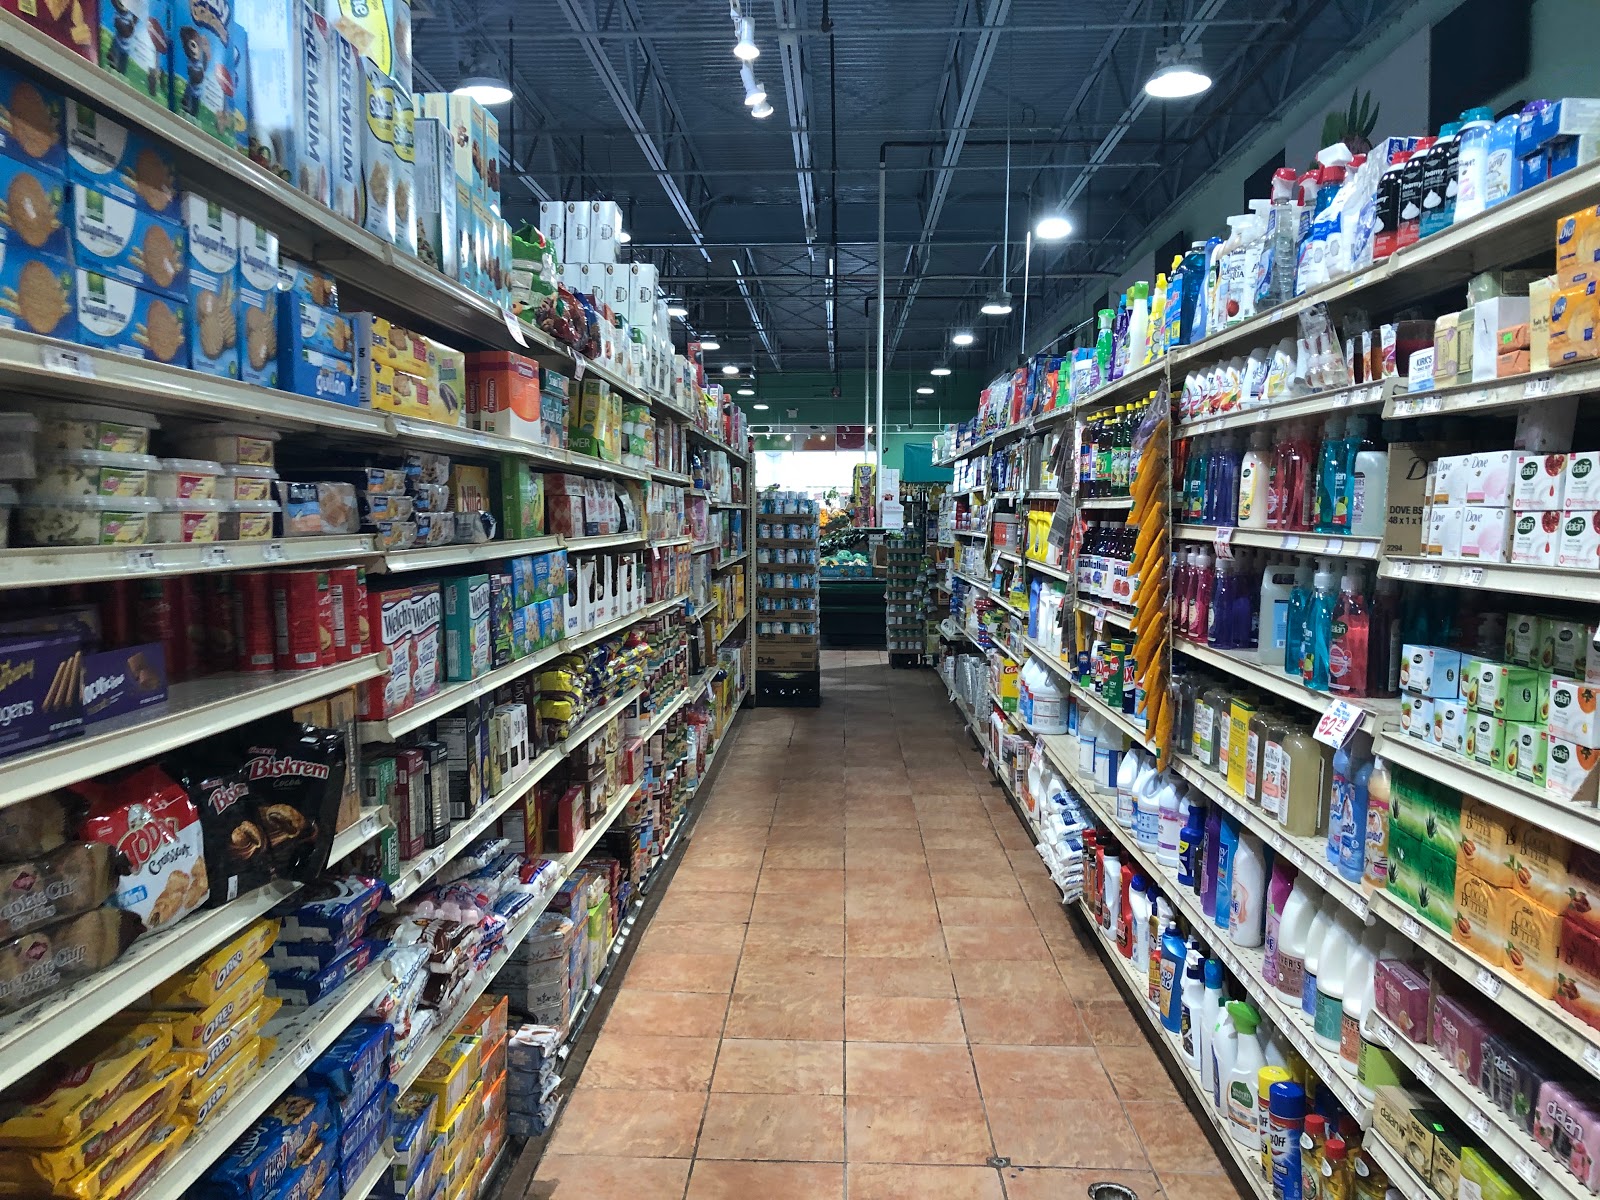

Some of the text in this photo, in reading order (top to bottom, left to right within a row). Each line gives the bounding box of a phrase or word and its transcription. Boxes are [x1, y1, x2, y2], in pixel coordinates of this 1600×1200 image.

[304, 5, 321, 163] PREMIUM
[340, 33, 354, 184] PREMIUM
[1424, 169, 1447, 178] foamy
[1402, 180, 1424, 190] foamy
[1559, 224, 1576, 240] Dial
[1417, 355, 1433, 367] KIRK'S
[1438, 459, 1453, 472] Dove
[1472, 456, 1489, 469] Dove
[1572, 462, 1591, 475] dalan
[1521, 465, 1538, 477] dalan
[1390, 505, 1412, 515] DOVE
[1432, 509, 1446, 522] Dove
[1465, 509, 1483, 523] Dove
[1388, 516, 1398, 525] 48
[1399, 517, 1405, 525] x
[1406, 516, 1410, 525] 1
[1411, 517, 1417, 525] x
[1518, 519, 1535, 533] dalan
[1566, 519, 1585, 533] dalan
[1386, 544, 1403, 552] 2294
[384, 603, 411, 633] Welch's
[412, 597, 440, 627] Welch's
[1332, 626, 1346, 635] alan
[757, 655, 776, 667] Dole
[1554, 693, 1571, 708] dalan
[1552, 747, 1570, 761] dalan
[250, 757, 330, 781] Biskrem
[1461, 891, 1488, 918] BUTTER
[1510, 920, 1541, 951] BUTTER
[202, 1001, 235, 1043] OREO
[1441, 1016, 1459, 1040] dalan
[198, 1034, 233, 1078] OREO
[1494, 1055, 1518, 1081] dalan
[1380, 1107, 1400, 1132] dalan
[1546, 1100, 1585, 1141] dalan
[1411, 1120, 1426, 1140] dalan
